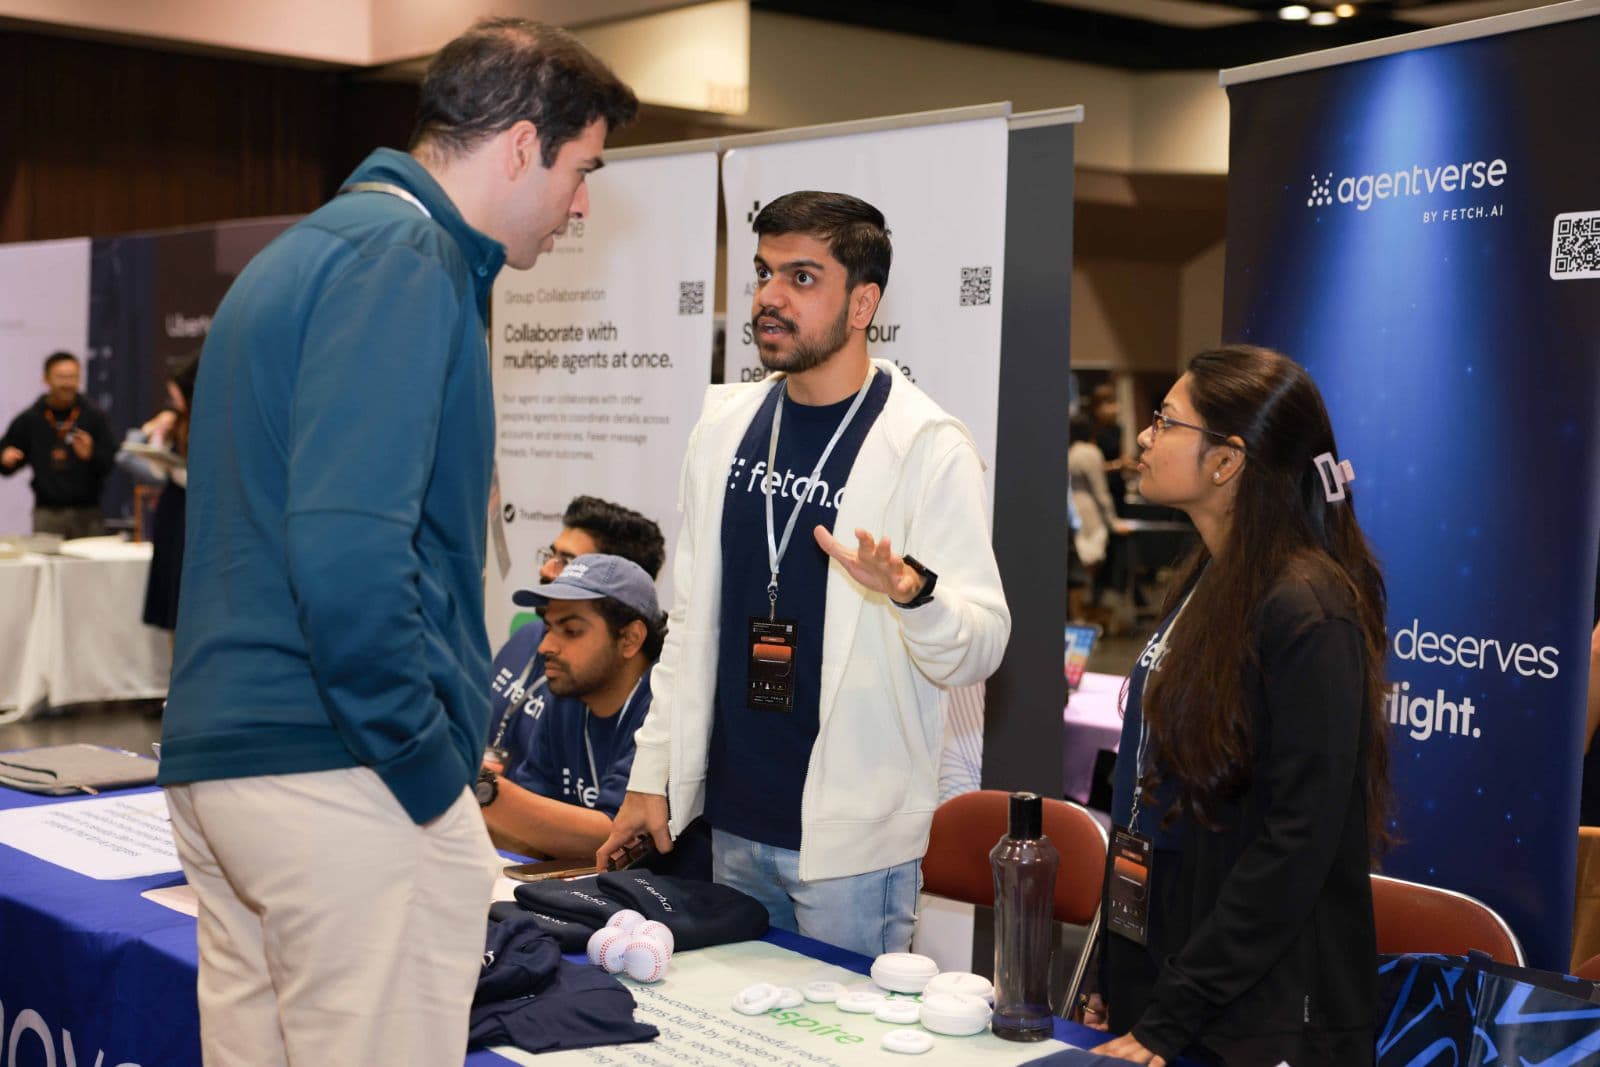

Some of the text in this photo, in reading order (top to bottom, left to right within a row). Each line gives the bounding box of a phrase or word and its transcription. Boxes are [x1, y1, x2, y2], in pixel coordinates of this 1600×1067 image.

[1337, 158, 1507, 211] agentverse
[1423, 204, 1503, 223] BY FETCH.AI
[505, 287, 606, 306] Group Collaboration
[503, 320, 618, 343] Collaborate with
[867, 325, 900, 343] our
[503, 349, 673, 374] multiple agents at once.
[1394, 618, 1559, 679] deserves
[769, 1007, 865, 1045] spire
